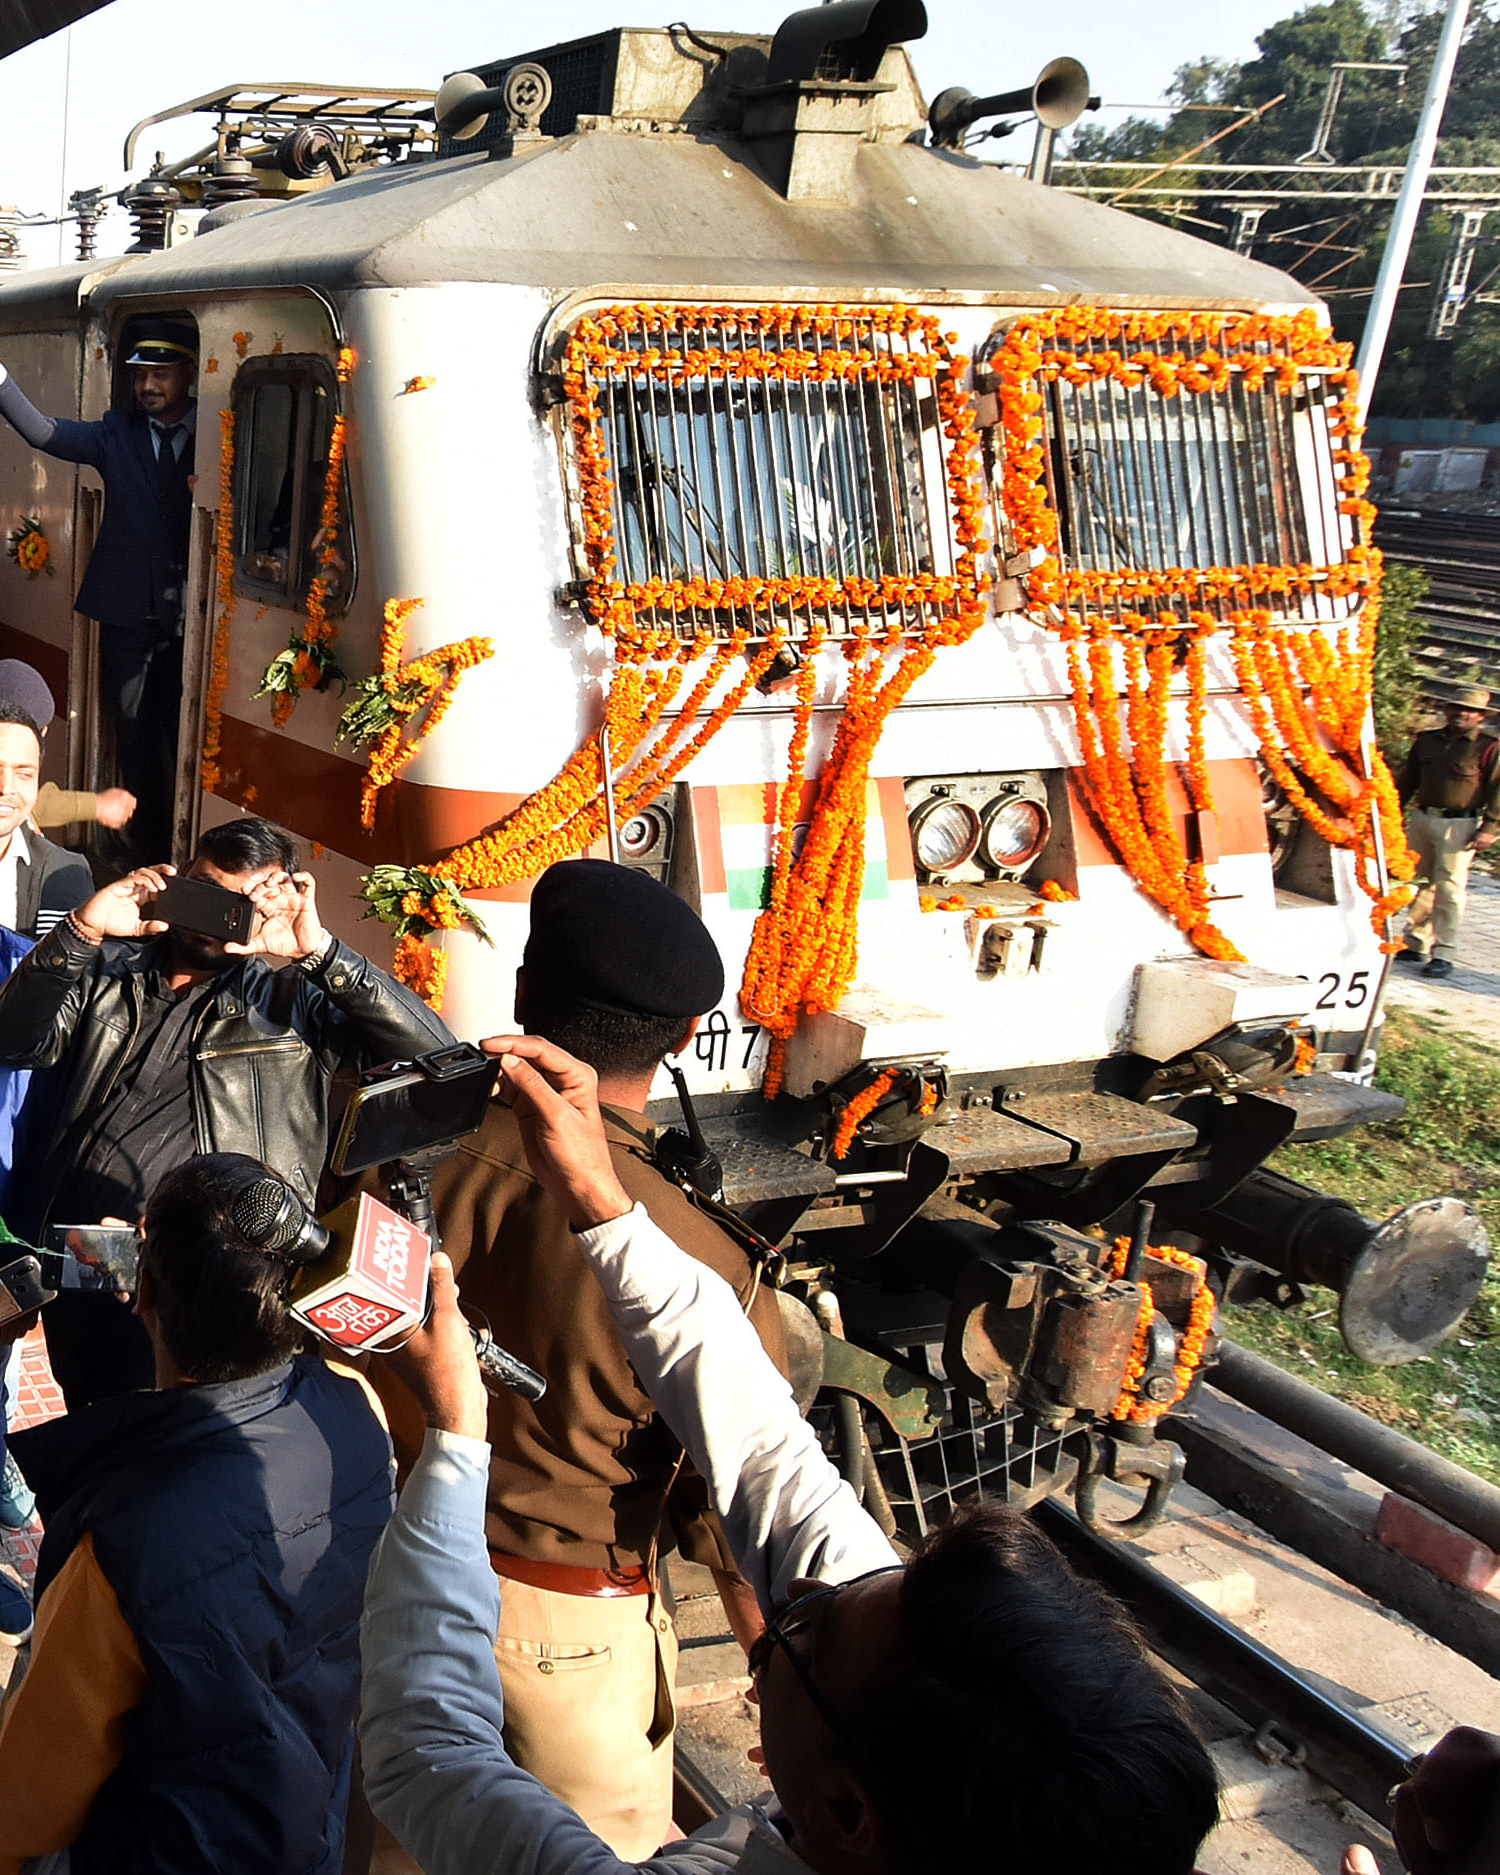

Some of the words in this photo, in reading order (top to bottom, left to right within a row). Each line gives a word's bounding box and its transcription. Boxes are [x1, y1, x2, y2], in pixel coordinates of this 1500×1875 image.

[1294, 971, 1370, 1010] 25
[695, 1010, 731, 1072] पी
[742, 1025, 761, 1069] 7
[373, 1220, 395, 1271] INDIA
[386, 1217, 412, 1291] TODAY
[316, 1296, 363, 1333] आज
[348, 1305, 391, 1335] तक
